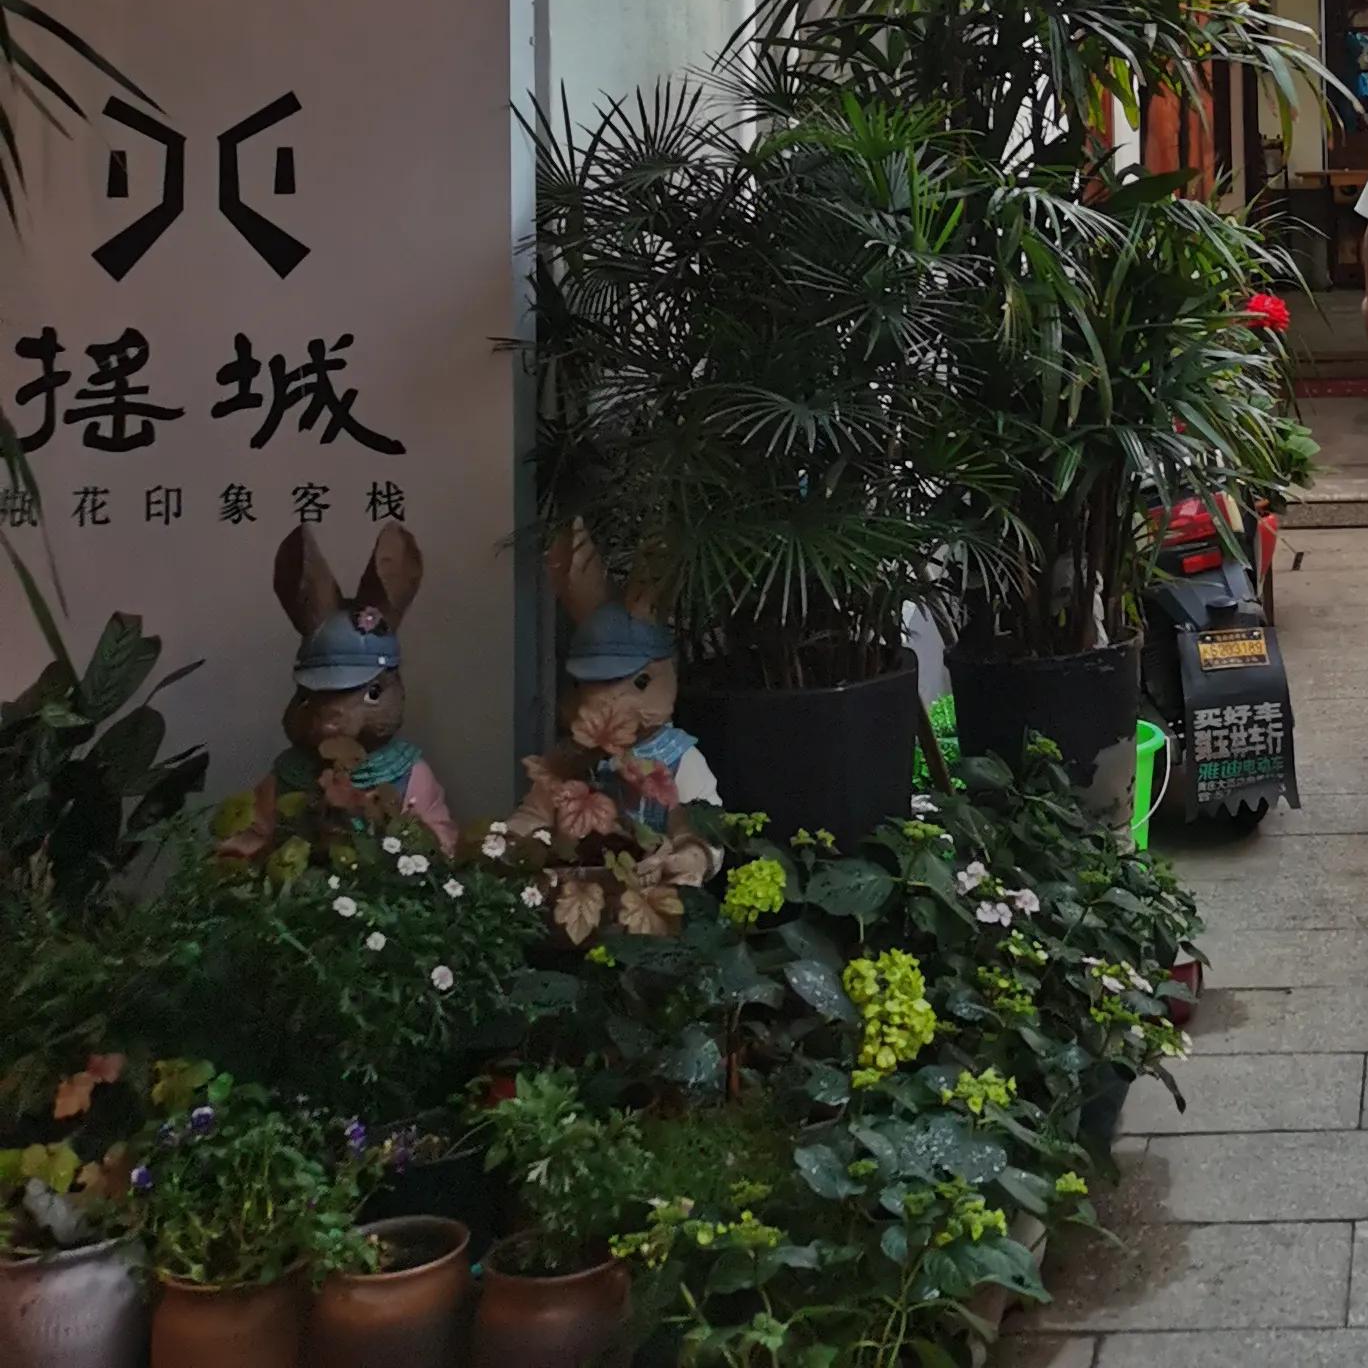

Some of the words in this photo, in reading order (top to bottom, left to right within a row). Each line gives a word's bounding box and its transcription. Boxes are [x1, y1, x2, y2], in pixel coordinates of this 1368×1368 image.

[8, 326, 406, 455] 摇城
[1193, 701, 1284, 729] 买好车
